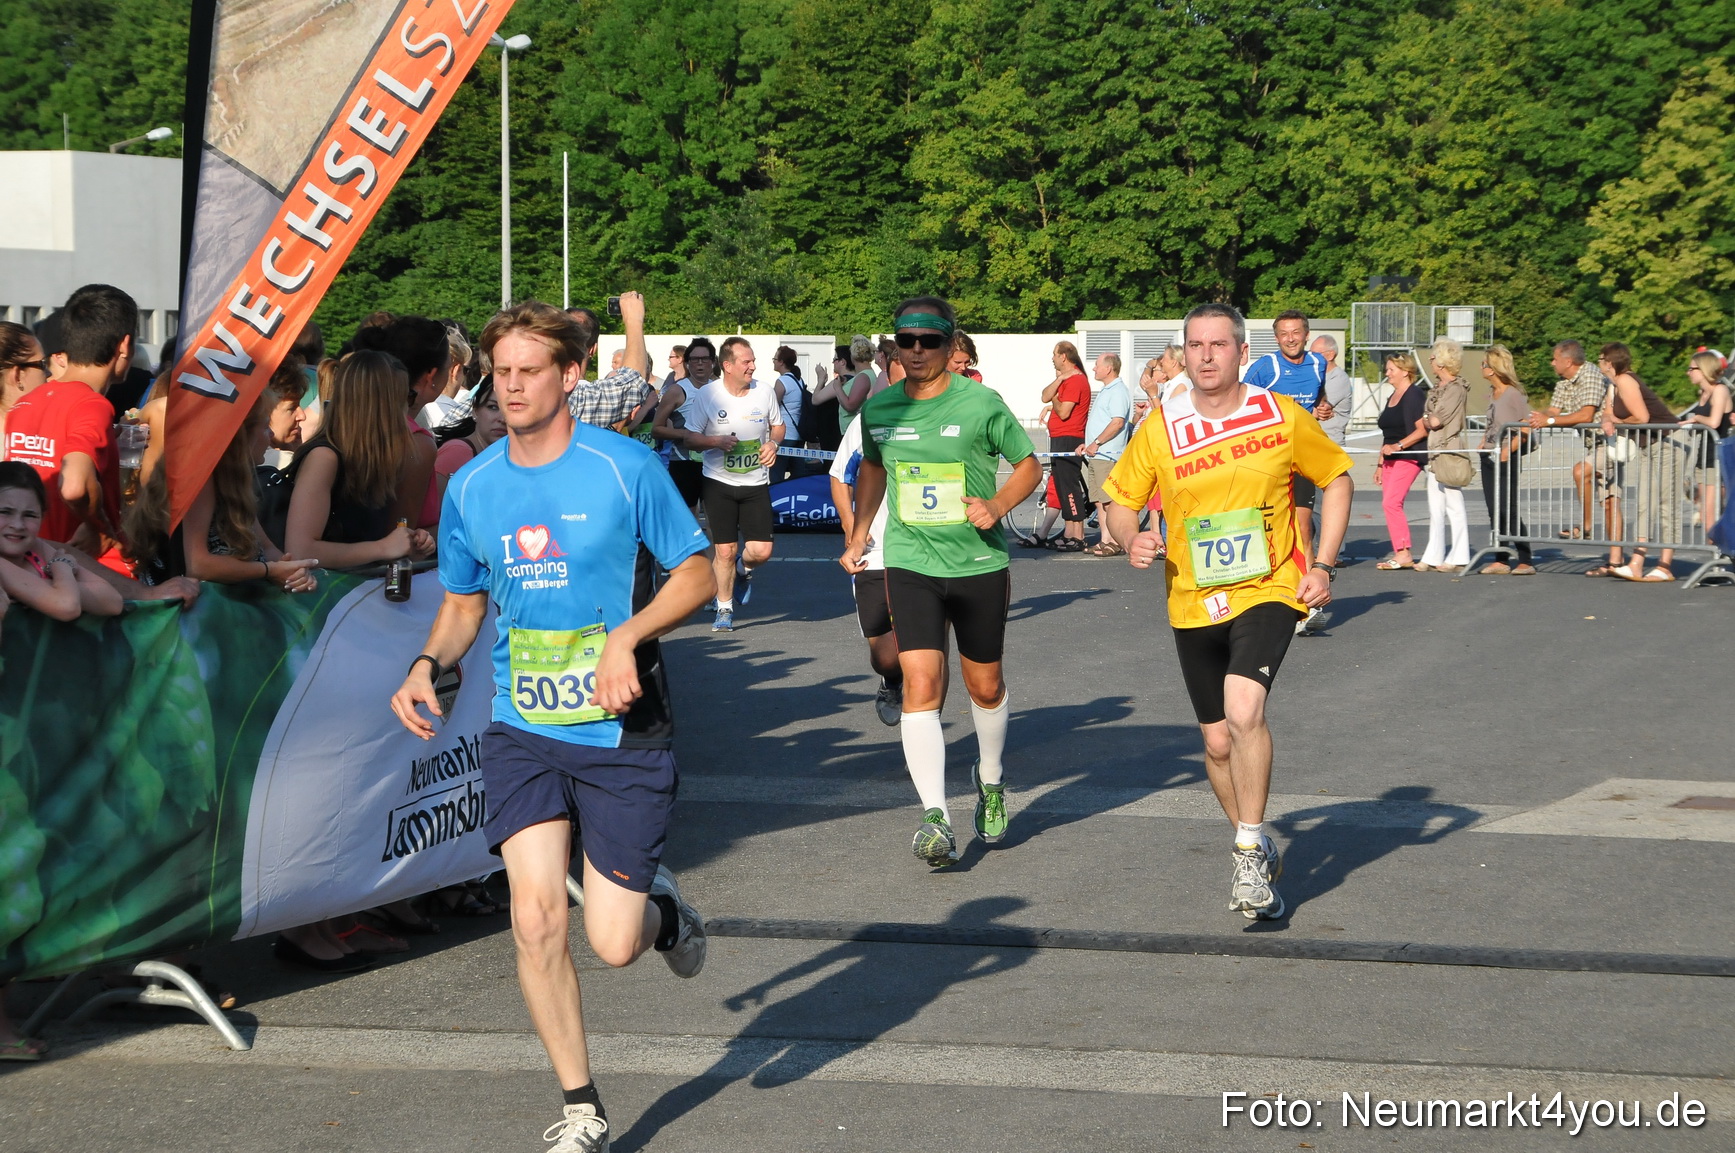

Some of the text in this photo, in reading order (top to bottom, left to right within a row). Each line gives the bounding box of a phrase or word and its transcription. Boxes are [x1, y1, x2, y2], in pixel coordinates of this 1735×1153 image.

[10, 432, 55, 457] Petry
[1174, 432, 1289, 481] MAX BÖGL
[726, 453, 759, 468] 5102
[922, 486, 938, 510] 5
[778, 503, 836, 524] Fisch
[501, 534, 514, 565] I
[1198, 534, 1252, 568] 797
[506, 558, 568, 580] camping
[544, 579, 569, 589] Berger
[516, 671, 596, 710] 5039
